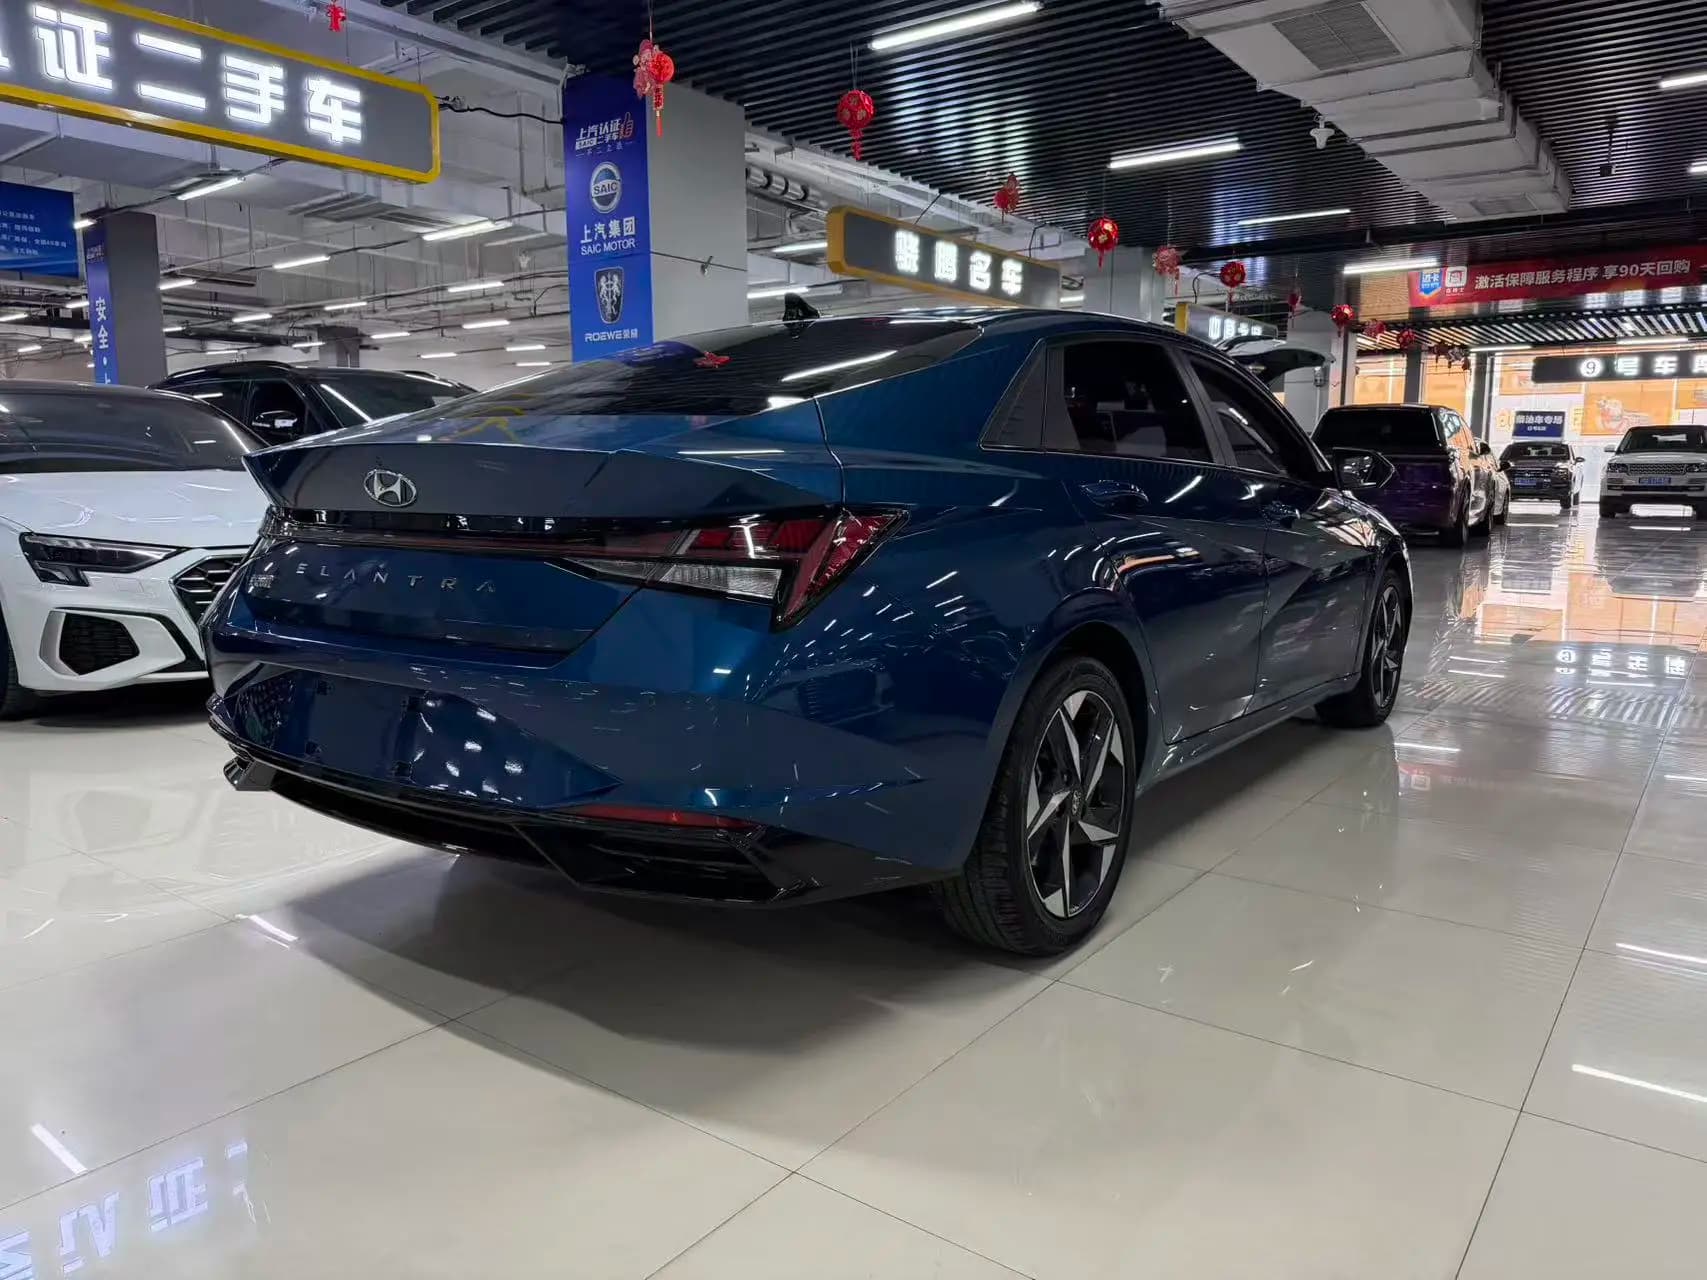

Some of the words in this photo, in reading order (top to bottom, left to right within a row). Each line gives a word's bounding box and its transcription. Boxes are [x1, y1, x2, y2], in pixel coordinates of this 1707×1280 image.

[0, 4, 364, 144] 证二手车
[579, 118, 621, 140] 上汽认证
[592, 181, 619, 197] SAIC
[580, 216, 635, 244] 上汽集团
[581, 240, 602, 256] SAIC
[603, 238, 636, 252] MOTOR
[1475, 266, 1600, 290] 激活保障服务程序
[1603, 259, 1691, 280] 享90天回购
[584, 330, 622, 342] ROEWE
[296, 562, 496, 593] ELANTRA
